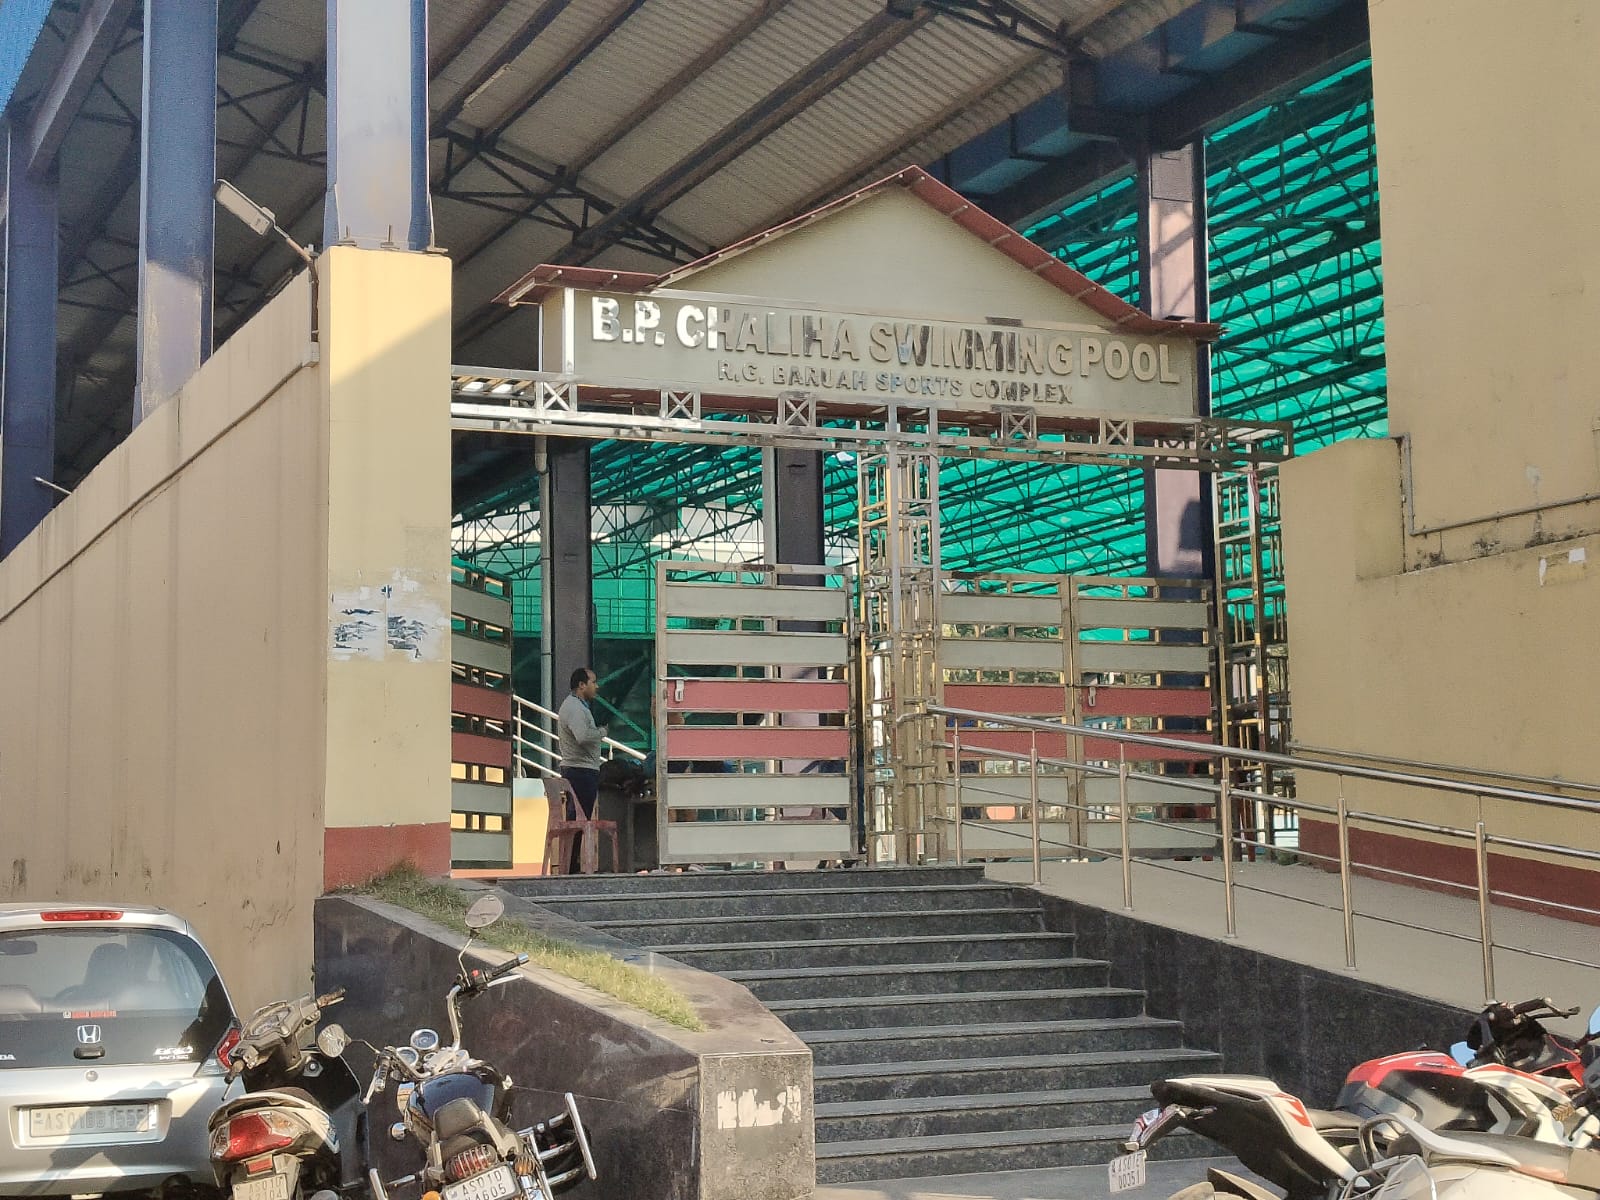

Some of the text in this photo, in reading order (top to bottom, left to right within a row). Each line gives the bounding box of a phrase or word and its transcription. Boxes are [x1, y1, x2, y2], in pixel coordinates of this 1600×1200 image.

[591, 296, 1180, 383] B.P. CHALIHA SWIMMING POOL
[718, 359, 1073, 404] R.G. BARUAH SPORTS COMPLEX
